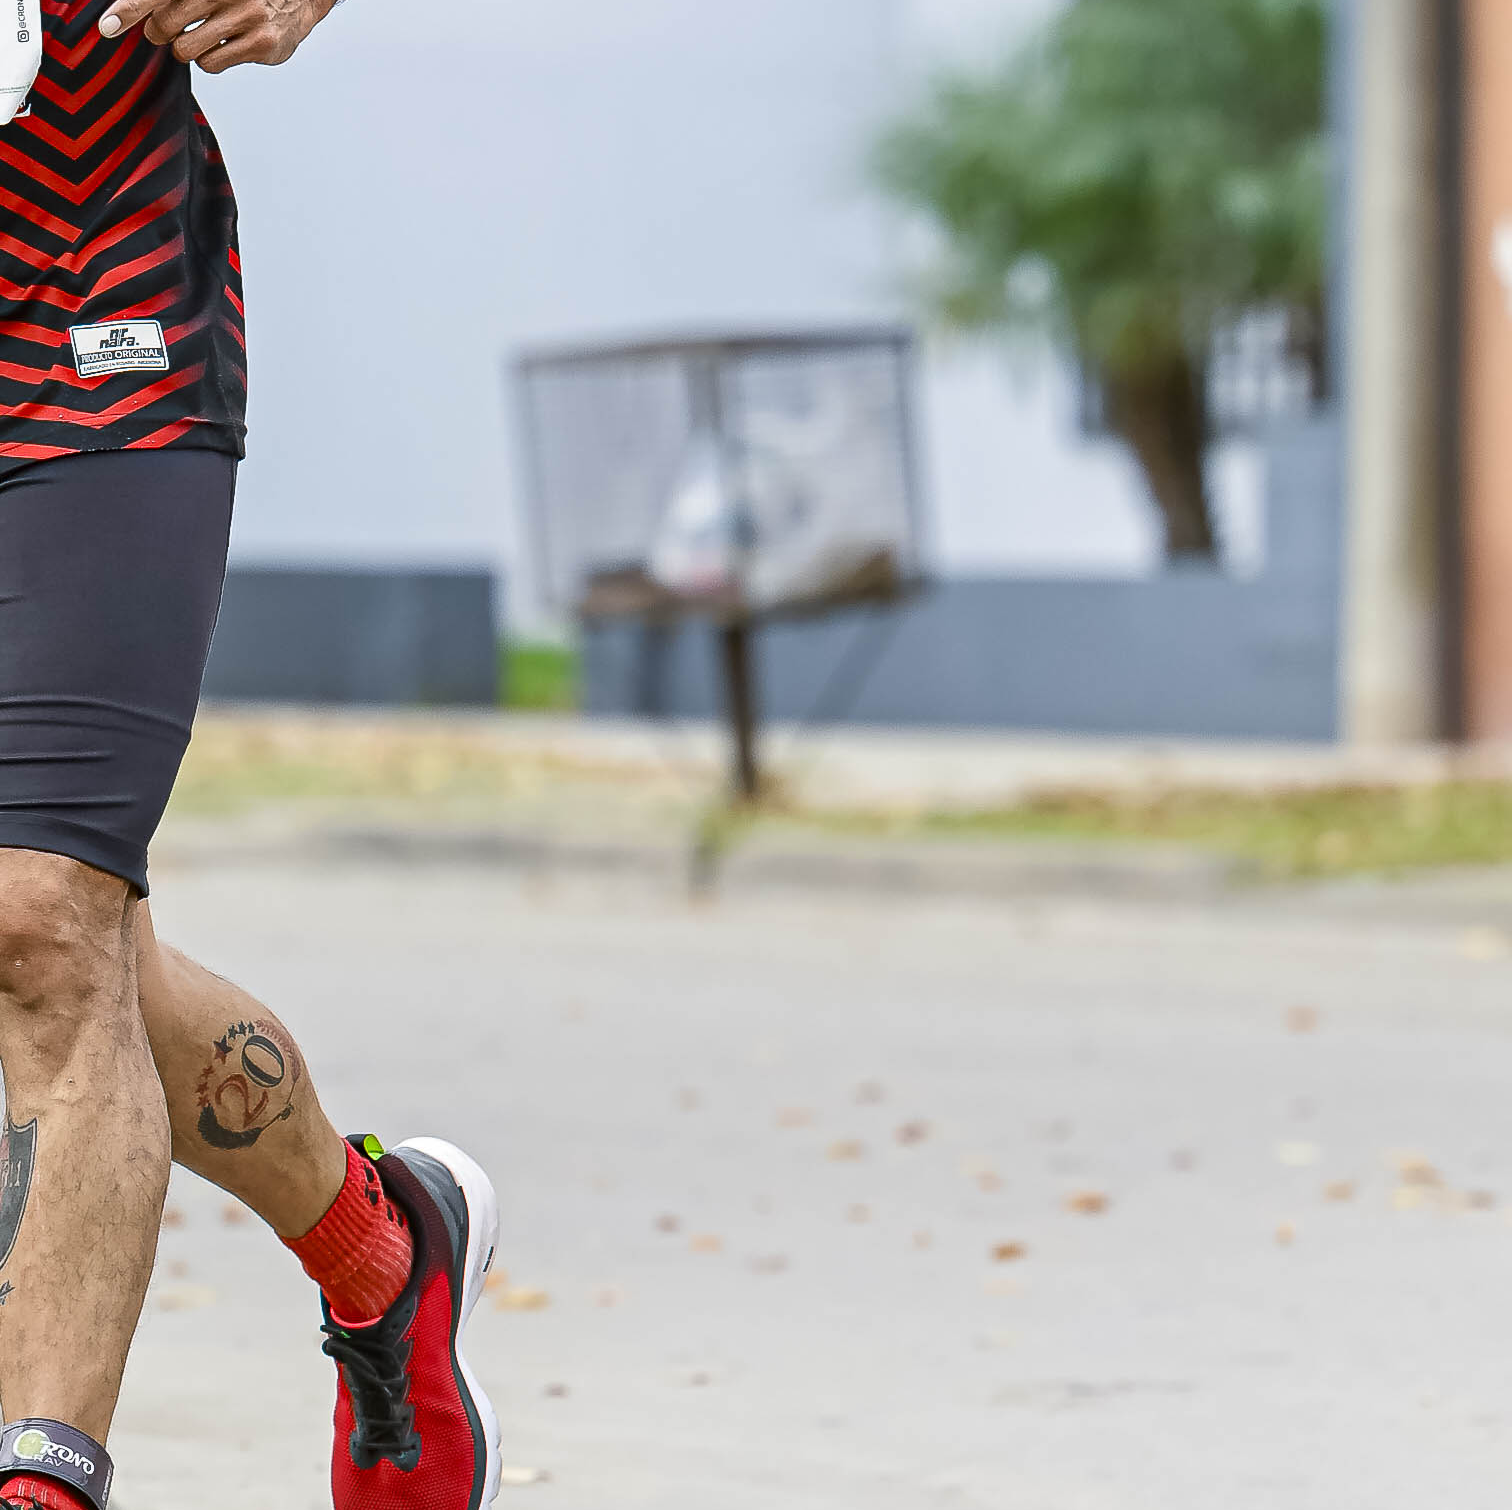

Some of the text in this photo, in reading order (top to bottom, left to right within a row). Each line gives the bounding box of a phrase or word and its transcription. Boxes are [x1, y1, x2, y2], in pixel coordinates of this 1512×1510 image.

[81, 349, 160, 363] PRODUCTO ORIGINAL
[13, 1429, 95, 1475] CRONO
[33, 1454, 63, 1467] RAV
